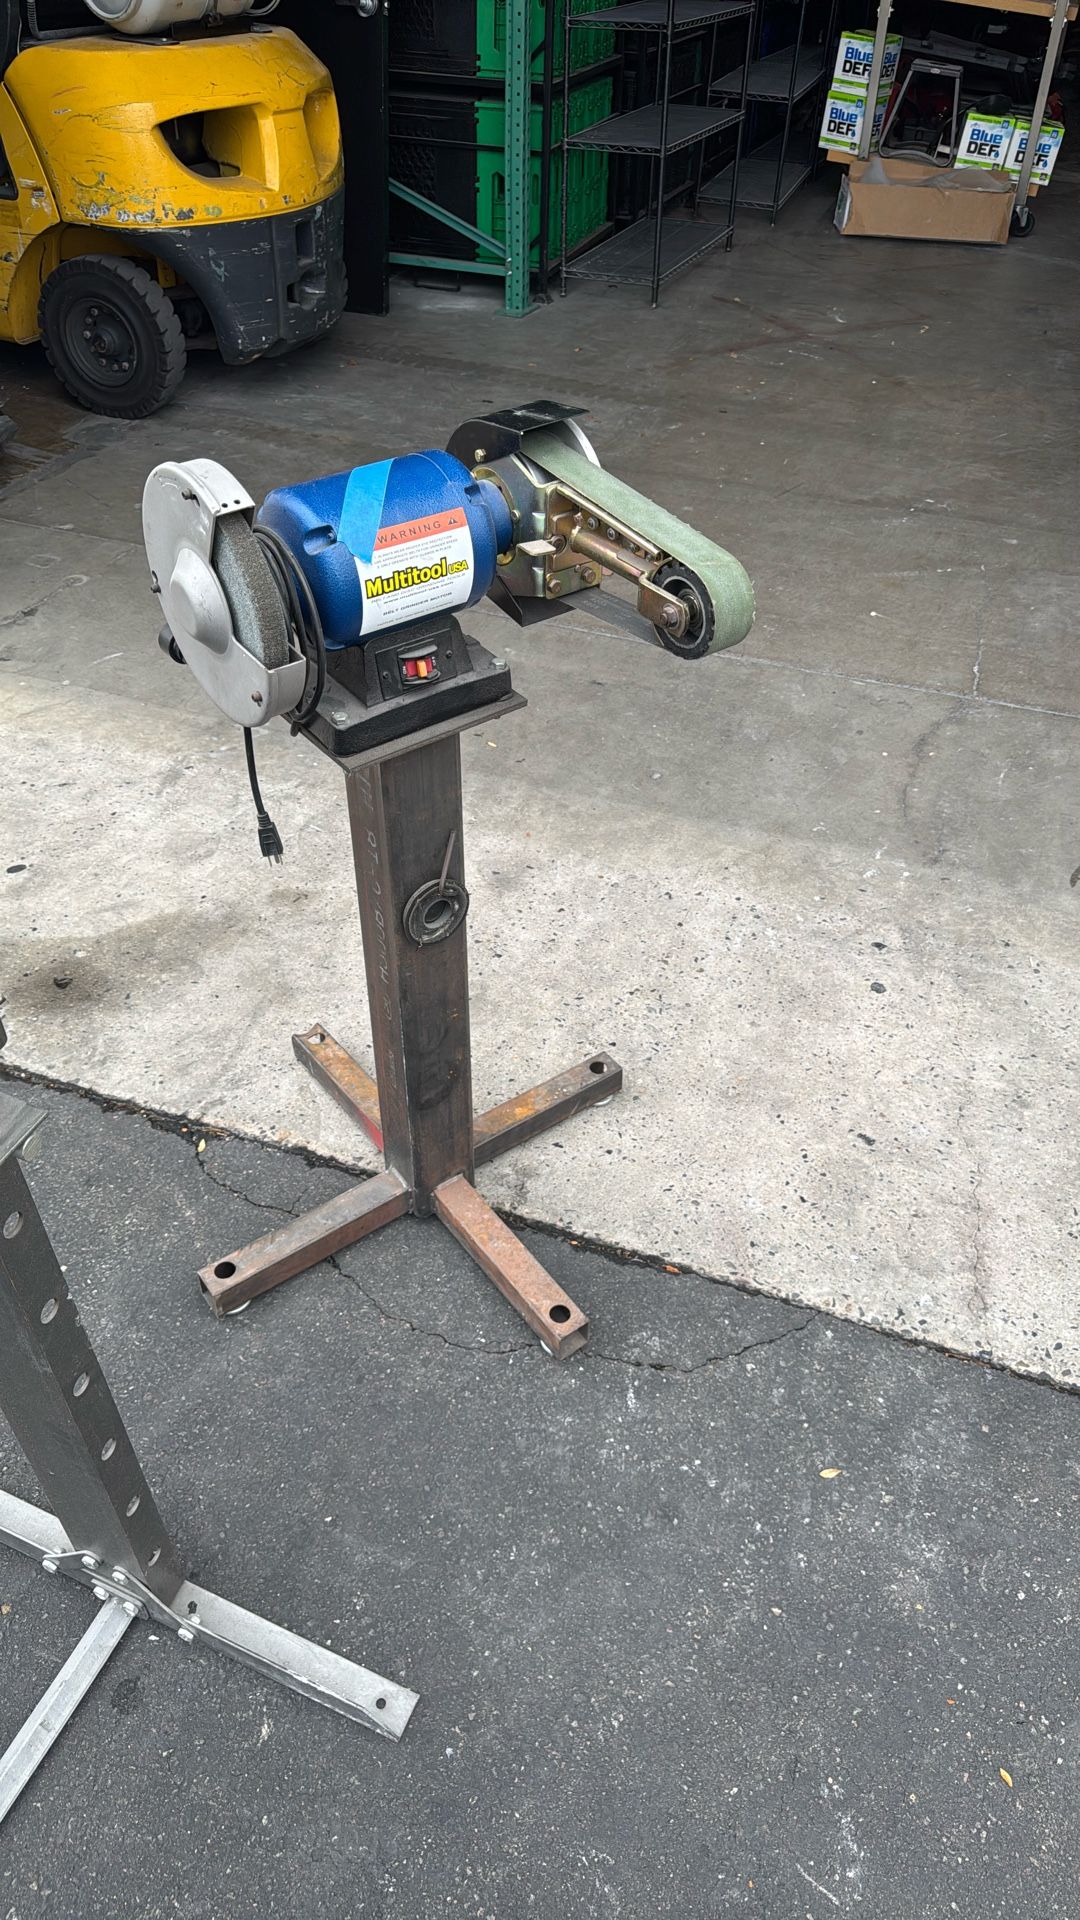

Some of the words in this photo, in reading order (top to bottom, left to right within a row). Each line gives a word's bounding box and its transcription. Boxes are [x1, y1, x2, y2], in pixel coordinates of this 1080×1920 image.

[842, 60, 872, 76] DEF
[829, 107, 858, 123] Blue
[827, 120, 856, 136] DEF
[970, 128, 1003, 144] Blue
[966, 141, 1000, 157] DEF
[1018, 138, 1052, 154] Bue
[377, 521, 441, 544] WARNING
[365, 556, 448, 599] Multitool
[448, 560, 469, 574] USA
